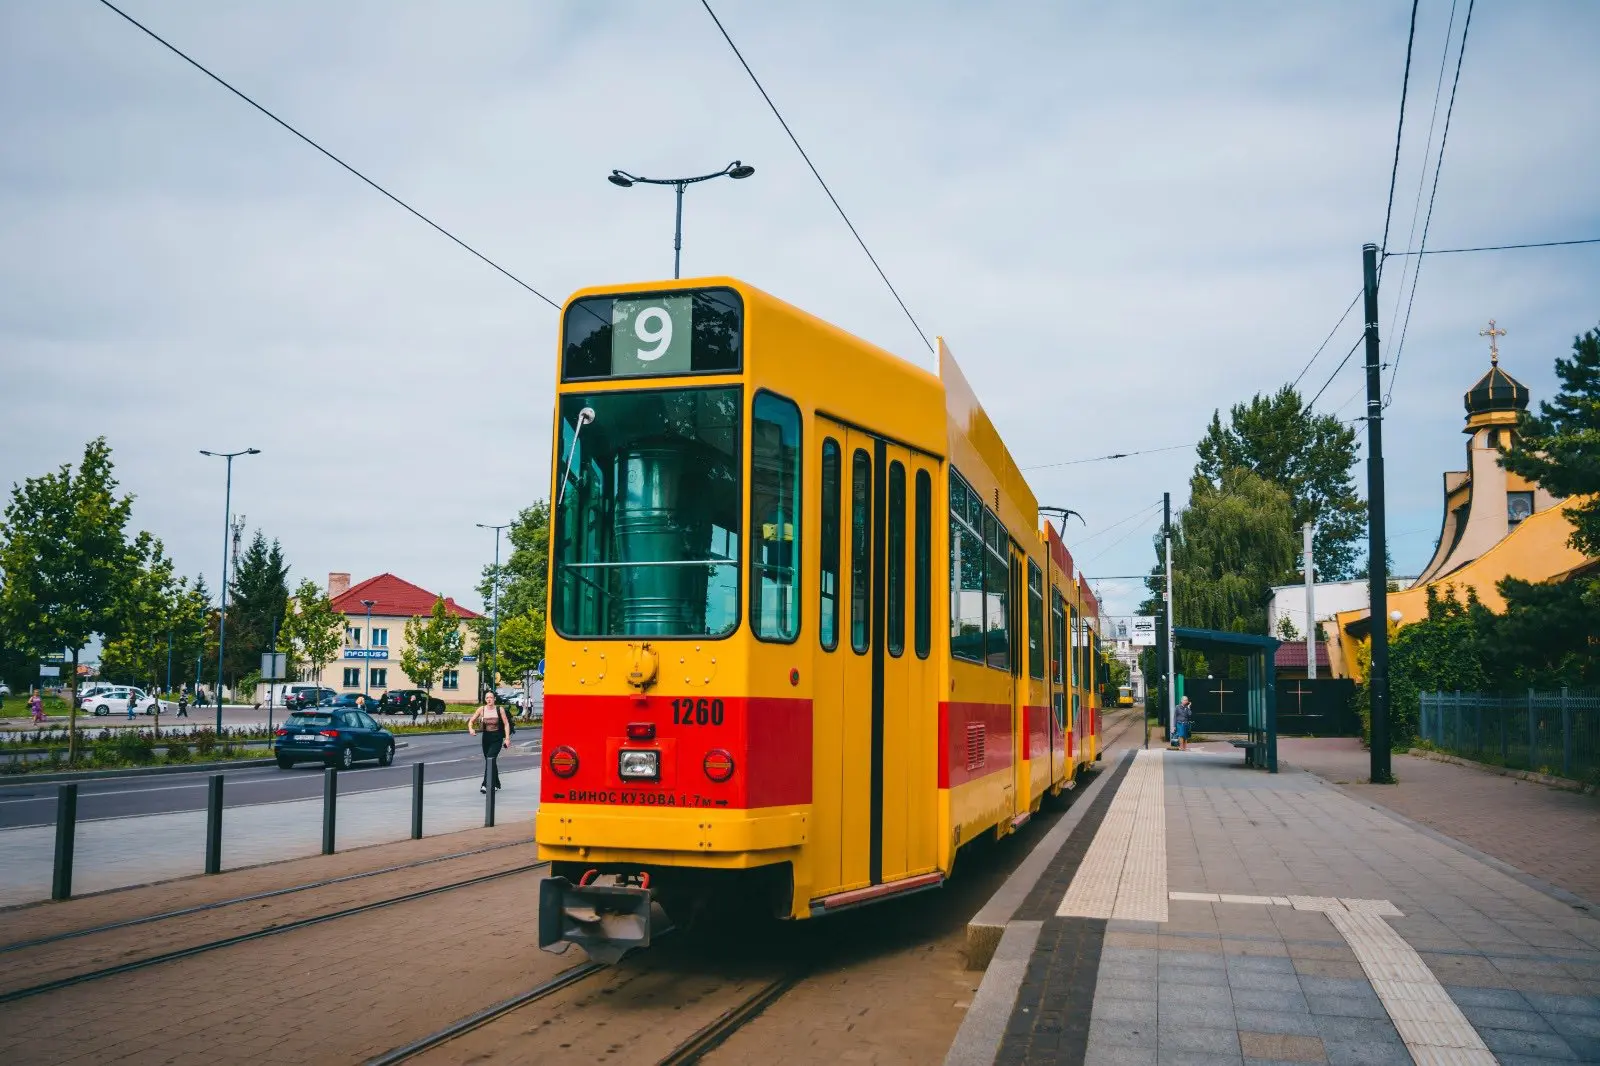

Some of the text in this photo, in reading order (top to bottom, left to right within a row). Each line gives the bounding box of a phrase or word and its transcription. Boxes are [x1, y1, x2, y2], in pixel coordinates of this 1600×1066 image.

[634, 306, 673, 361] 9
[672, 698, 724, 726] 1260
[569, 789, 617, 804] ВИНОС
[621, 792, 676, 806] КУЗОВА
